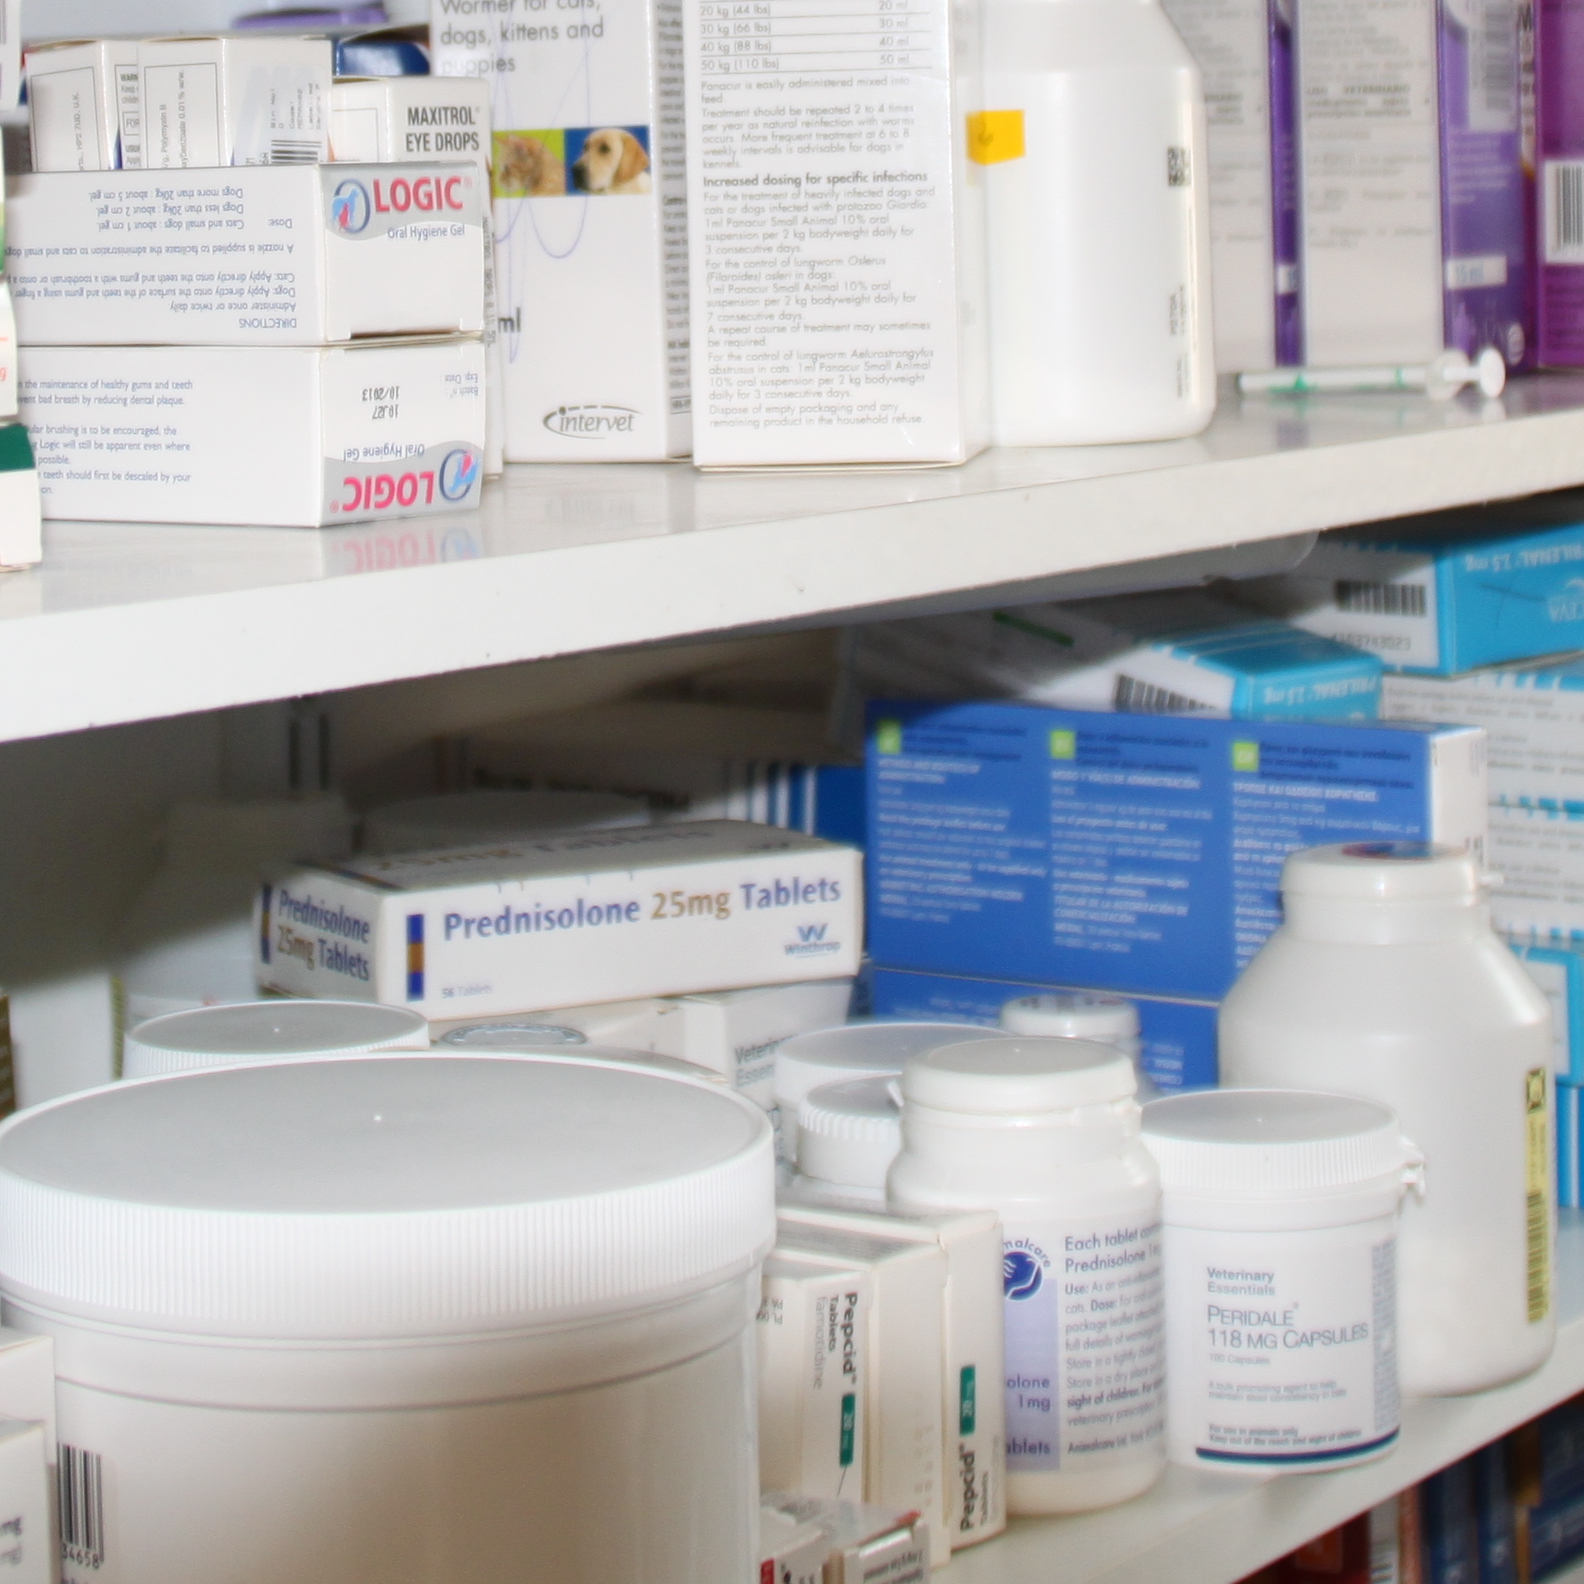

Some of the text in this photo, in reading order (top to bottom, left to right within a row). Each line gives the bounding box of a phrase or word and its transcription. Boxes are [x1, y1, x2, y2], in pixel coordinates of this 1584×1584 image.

[440, 15, 604, 50] dogs, kittens and
[407, 106, 477, 127] MAXITROL
[406, 130, 480, 153] EYE DROPS
[372, 176, 464, 214] LOGIC
[388, 222, 466, 241] Oral Hygiene Gel
[558, 408, 636, 435] intervet
[342, 469, 436, 512] LOGIC
[277, 888, 370, 945] Prednisolone
[442, 876, 842, 944] Prednisolone 25mg Tablets
[275, 929, 370, 984] 25mg Tablets
[784, 938, 842, 958] Winthrop
[1207, 1266, 1275, 1285] Veterinary
[1207, 1281, 1276, 1297] Essentials
[1207, 1304, 1294, 1327] PERIDALE
[842, 1291, 858, 1376] Pepcid
[1209, 1322, 1369, 1350] 118 MG CAPSULES
